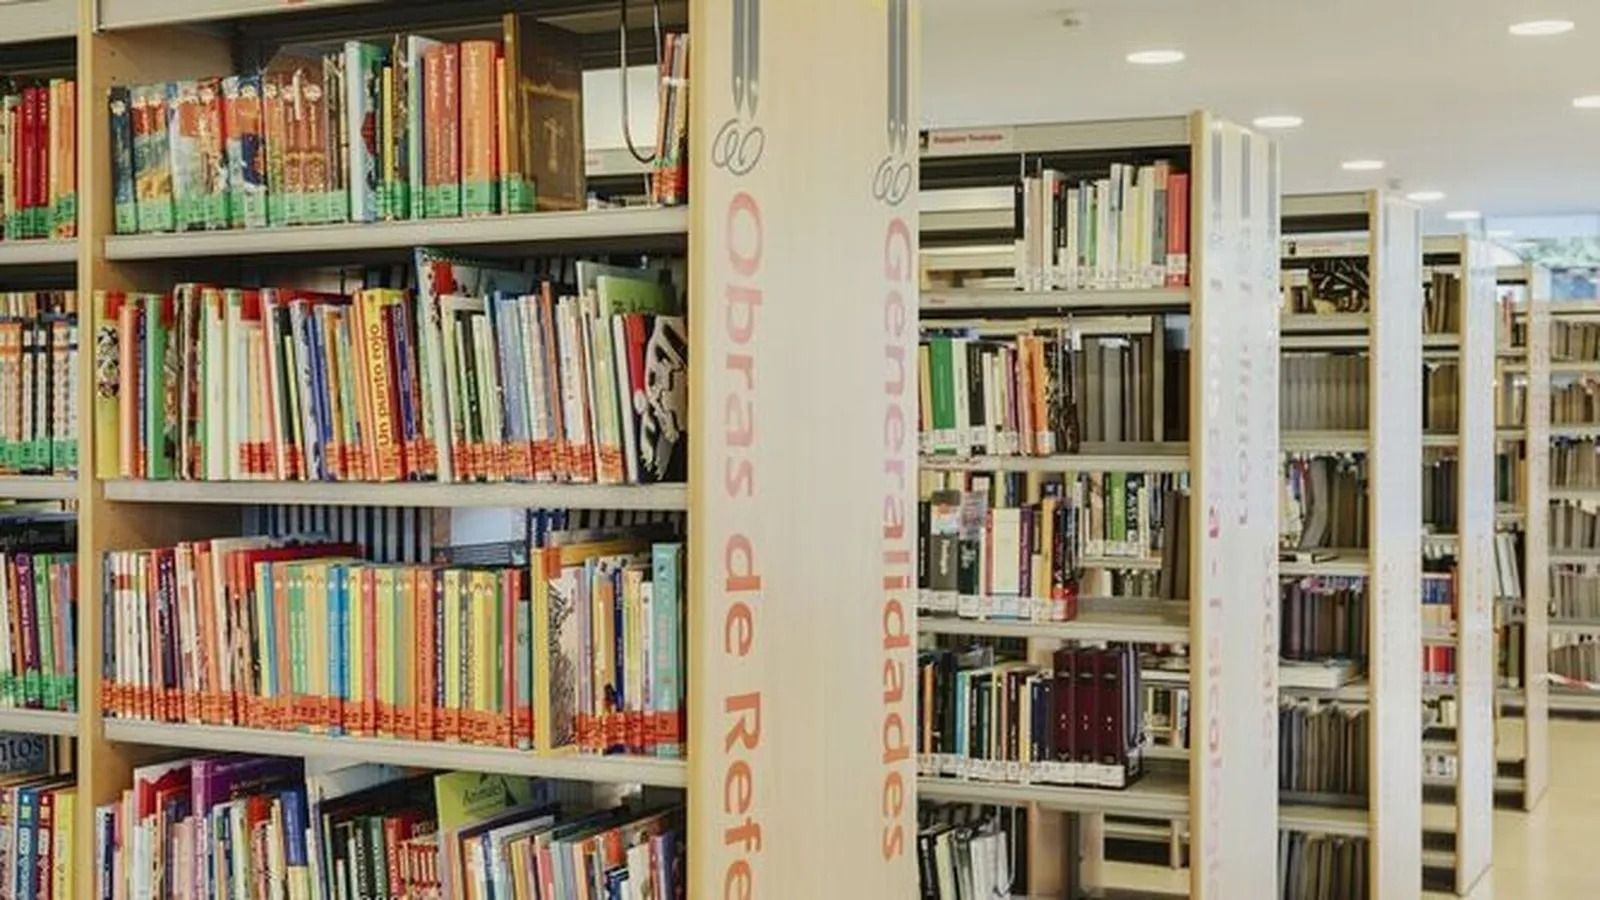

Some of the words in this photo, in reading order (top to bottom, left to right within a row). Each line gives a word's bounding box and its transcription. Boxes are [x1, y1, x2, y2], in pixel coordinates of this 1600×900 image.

[370, 323, 384, 361] rojo
[373, 363, 390, 419] punto
[723, 191, 764, 500] Obras
[377, 421, 391, 447] Un
[723, 528, 763, 658] de
[882, 216, 912, 861] Generalidades
[723, 690, 764, 900] Refe
